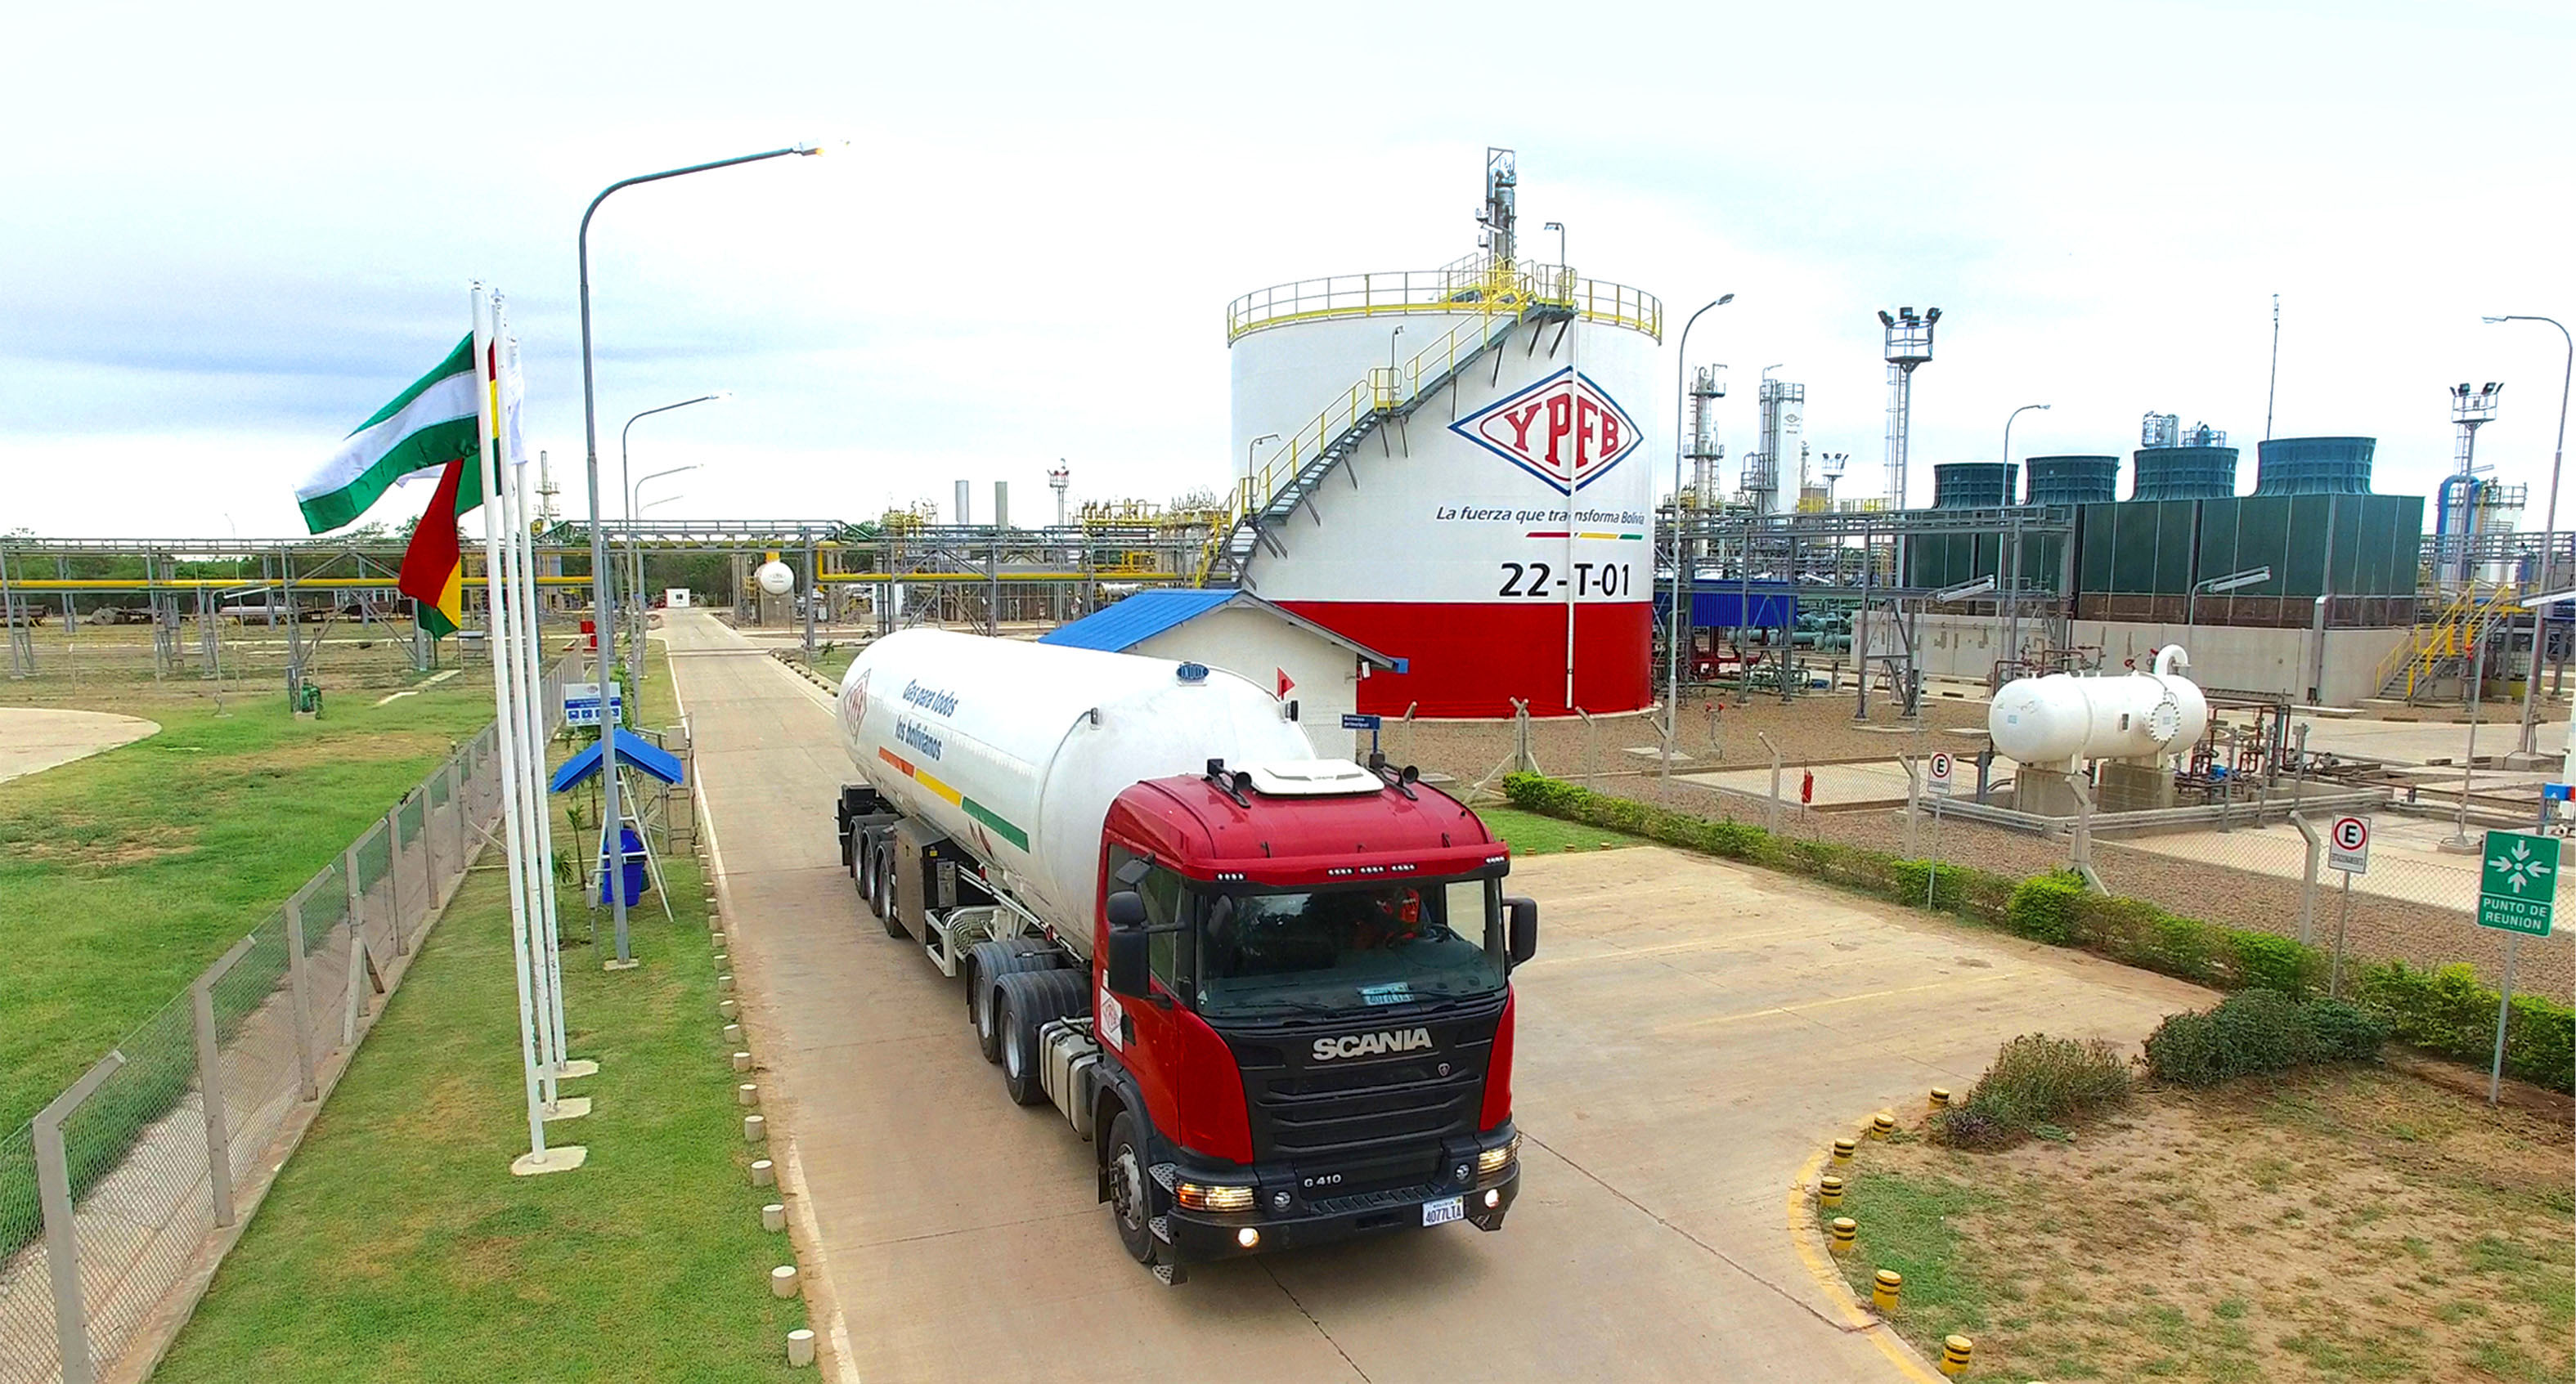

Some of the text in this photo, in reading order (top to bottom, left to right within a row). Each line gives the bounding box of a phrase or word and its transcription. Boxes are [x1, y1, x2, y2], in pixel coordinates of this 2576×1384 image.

[1504, 392, 1618, 468] YPFB
[1437, 506, 1645, 526] La fuerza que transforma Bolivia
[1498, 562, 1629, 597] 22-T-01
[903, 679, 958, 718] Gas para todos
[895, 714, 942, 761] los bolivianos
[1936, 759, 1945, 773] E
[2345, 825, 2357, 844] E
[2483, 898, 2547, 917] PUNTO DE
[2485, 911, 2542, 930] REUNION
[1313, 1028, 1434, 1060] SCANIA
[1304, 1174, 1342, 1187] G 410
